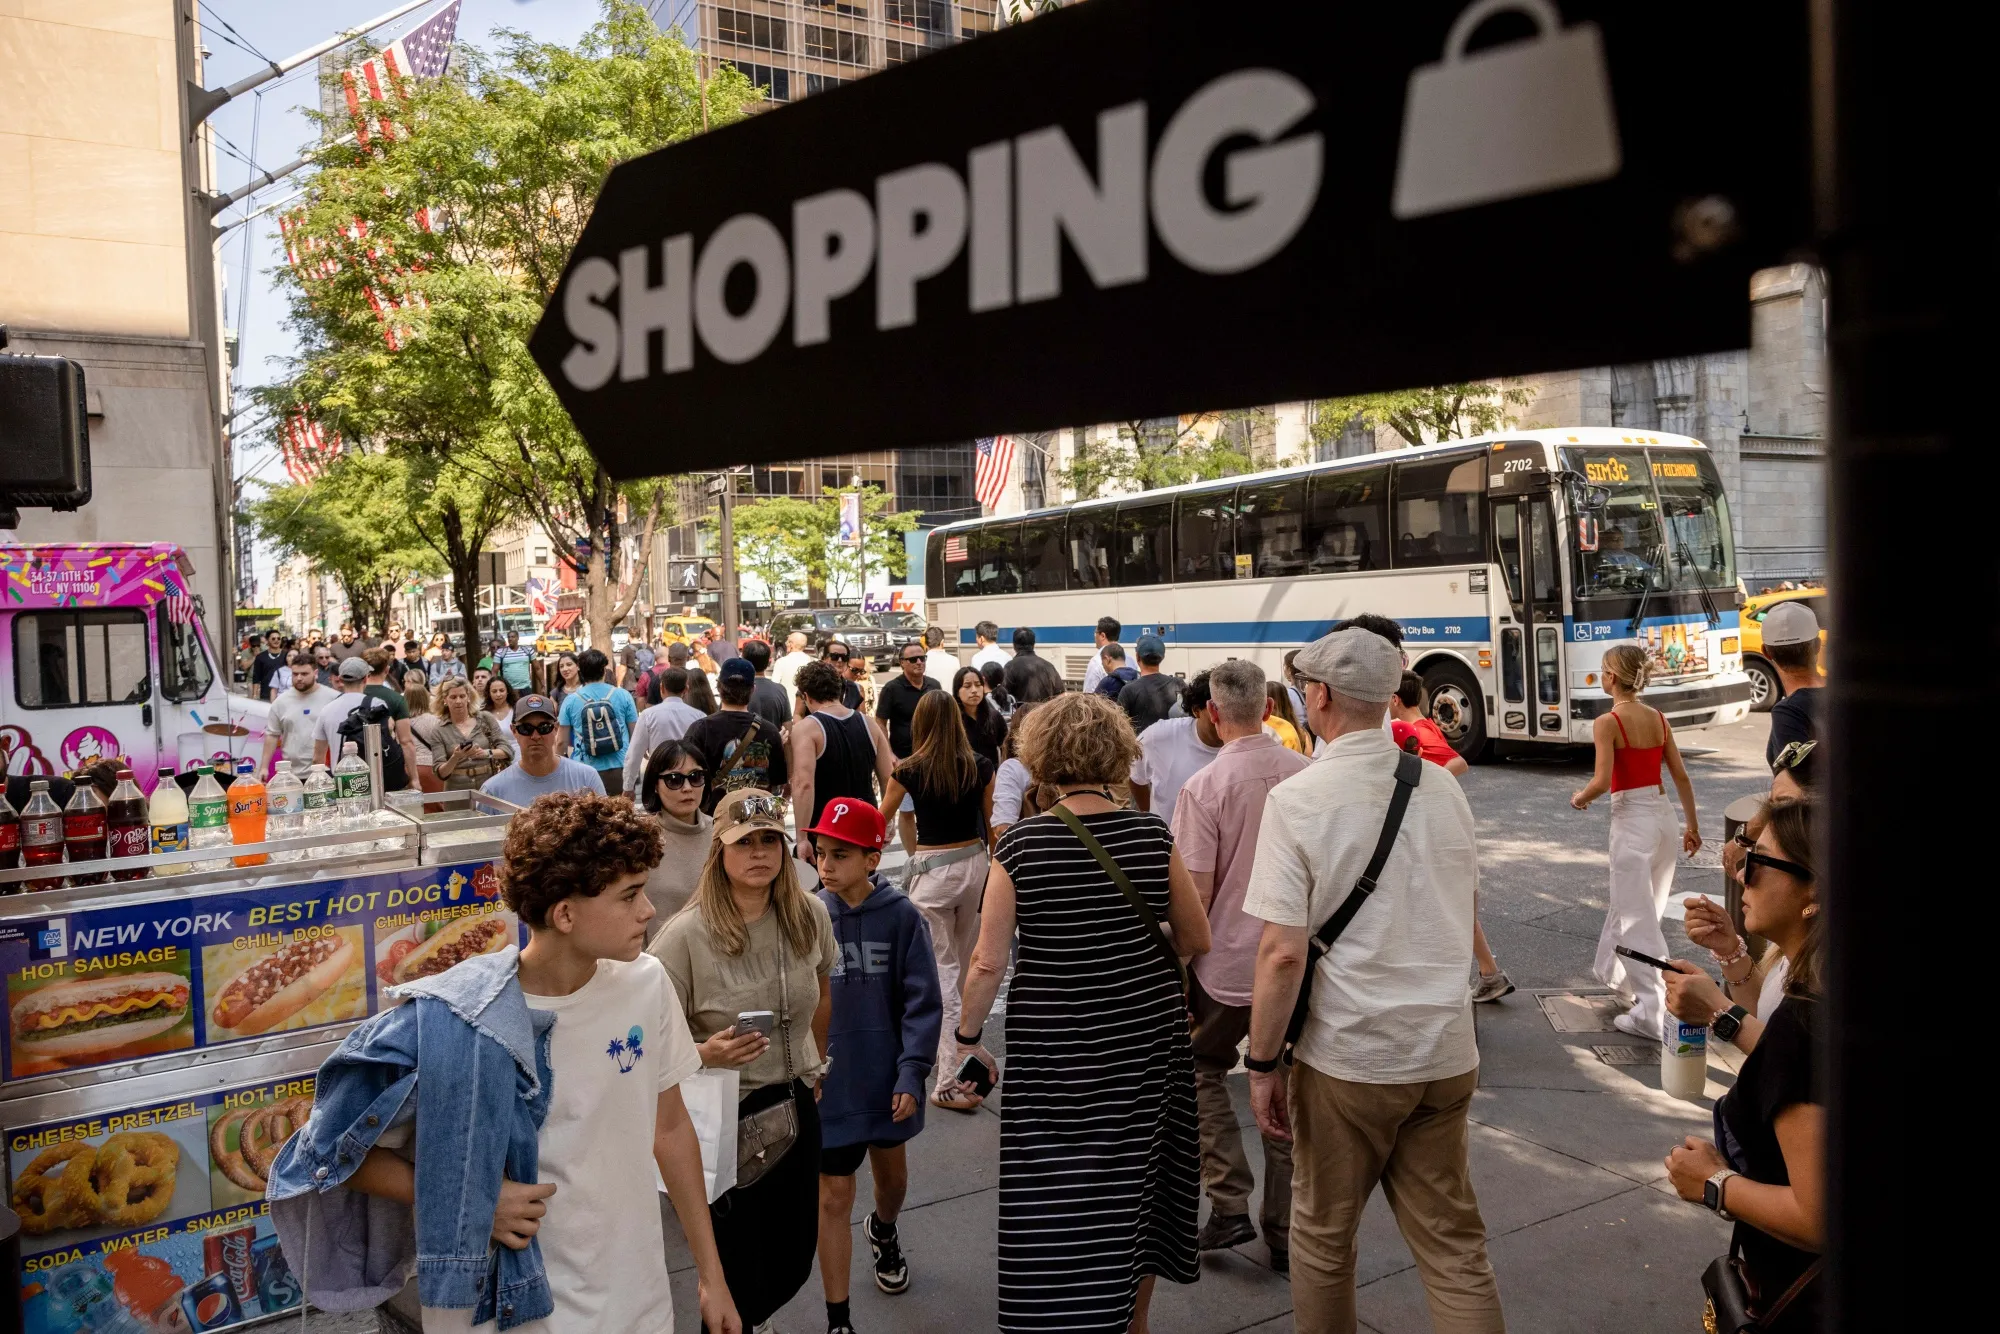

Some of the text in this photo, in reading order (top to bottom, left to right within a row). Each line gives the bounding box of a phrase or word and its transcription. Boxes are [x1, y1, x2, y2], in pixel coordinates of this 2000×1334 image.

[561, 67, 1325, 392] SHOPPING
[1504, 458, 1532, 473] 2702
[1664, 462, 1697, 478] RICHMOND
[31, 570, 95, 583] 34-37 11TH ST
[32, 582, 96, 594] L.I.C. NY 11106
[864, 592, 915, 613] FedEx
[1407, 626, 1421, 636] City
[1422, 626, 1435, 634] Bus
[1444, 626, 1461, 634] 2702
[1594, 625, 1611, 635] 2702
[235, 798, 262, 813] Sunst
[832, 803, 849, 823] P
[74, 883, 442, 951] NEW YORK BEST HOT DOG
[375, 911, 416, 929] CHILI
[419, 903, 480, 922] CHEESE
[44, 932, 61, 941] AM
[46, 938, 61, 947] EX
[233, 923, 336, 951] CHILI DOG
[21, 946, 178, 982] HOT SAUSAGE
[1681, 1027, 1706, 1037] CALPICO
[224, 1087, 268, 1110] HOT
[12, 1101, 203, 1152] CHEESE PRETZEL
[25, 1248, 84, 1273] SODA
[101, 1227, 169, 1255] WATER
[186, 1204, 270, 1235] SNAPPLE
